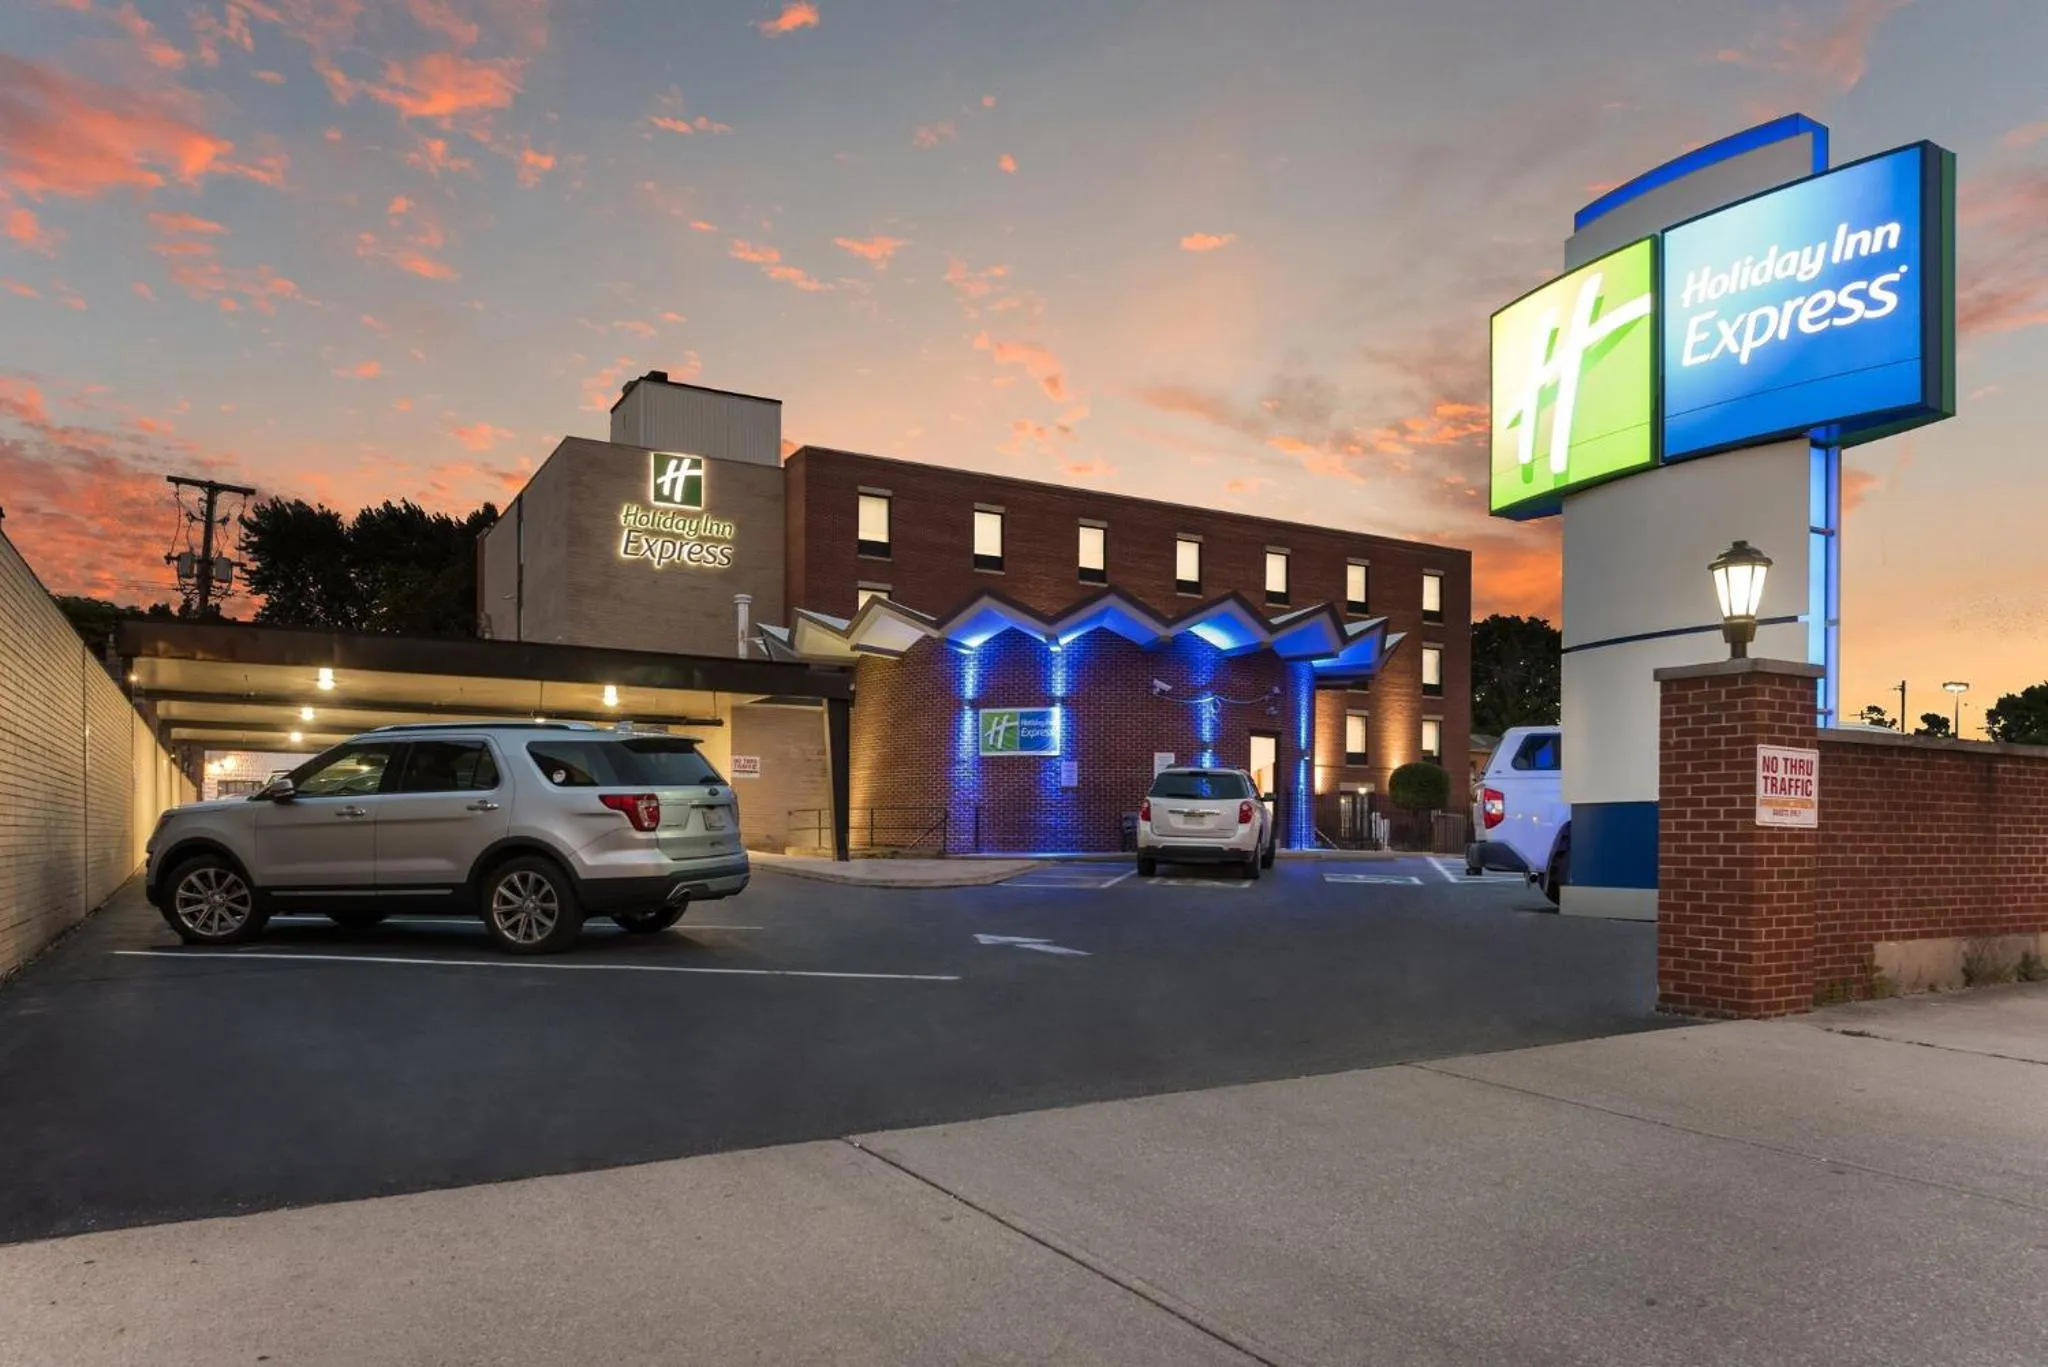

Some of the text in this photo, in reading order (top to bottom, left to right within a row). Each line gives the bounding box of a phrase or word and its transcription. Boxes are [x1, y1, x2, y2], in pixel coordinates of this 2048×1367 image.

[1681, 222, 1901, 308] Holiday Inn
[1682, 271, 1902, 367] Express
[621, 504, 734, 539] Holiday Inn
[622, 528, 734, 568] Express
[1762, 755, 1814, 777] NO THRU
[1762, 775, 1813, 797] TRAFFIC
